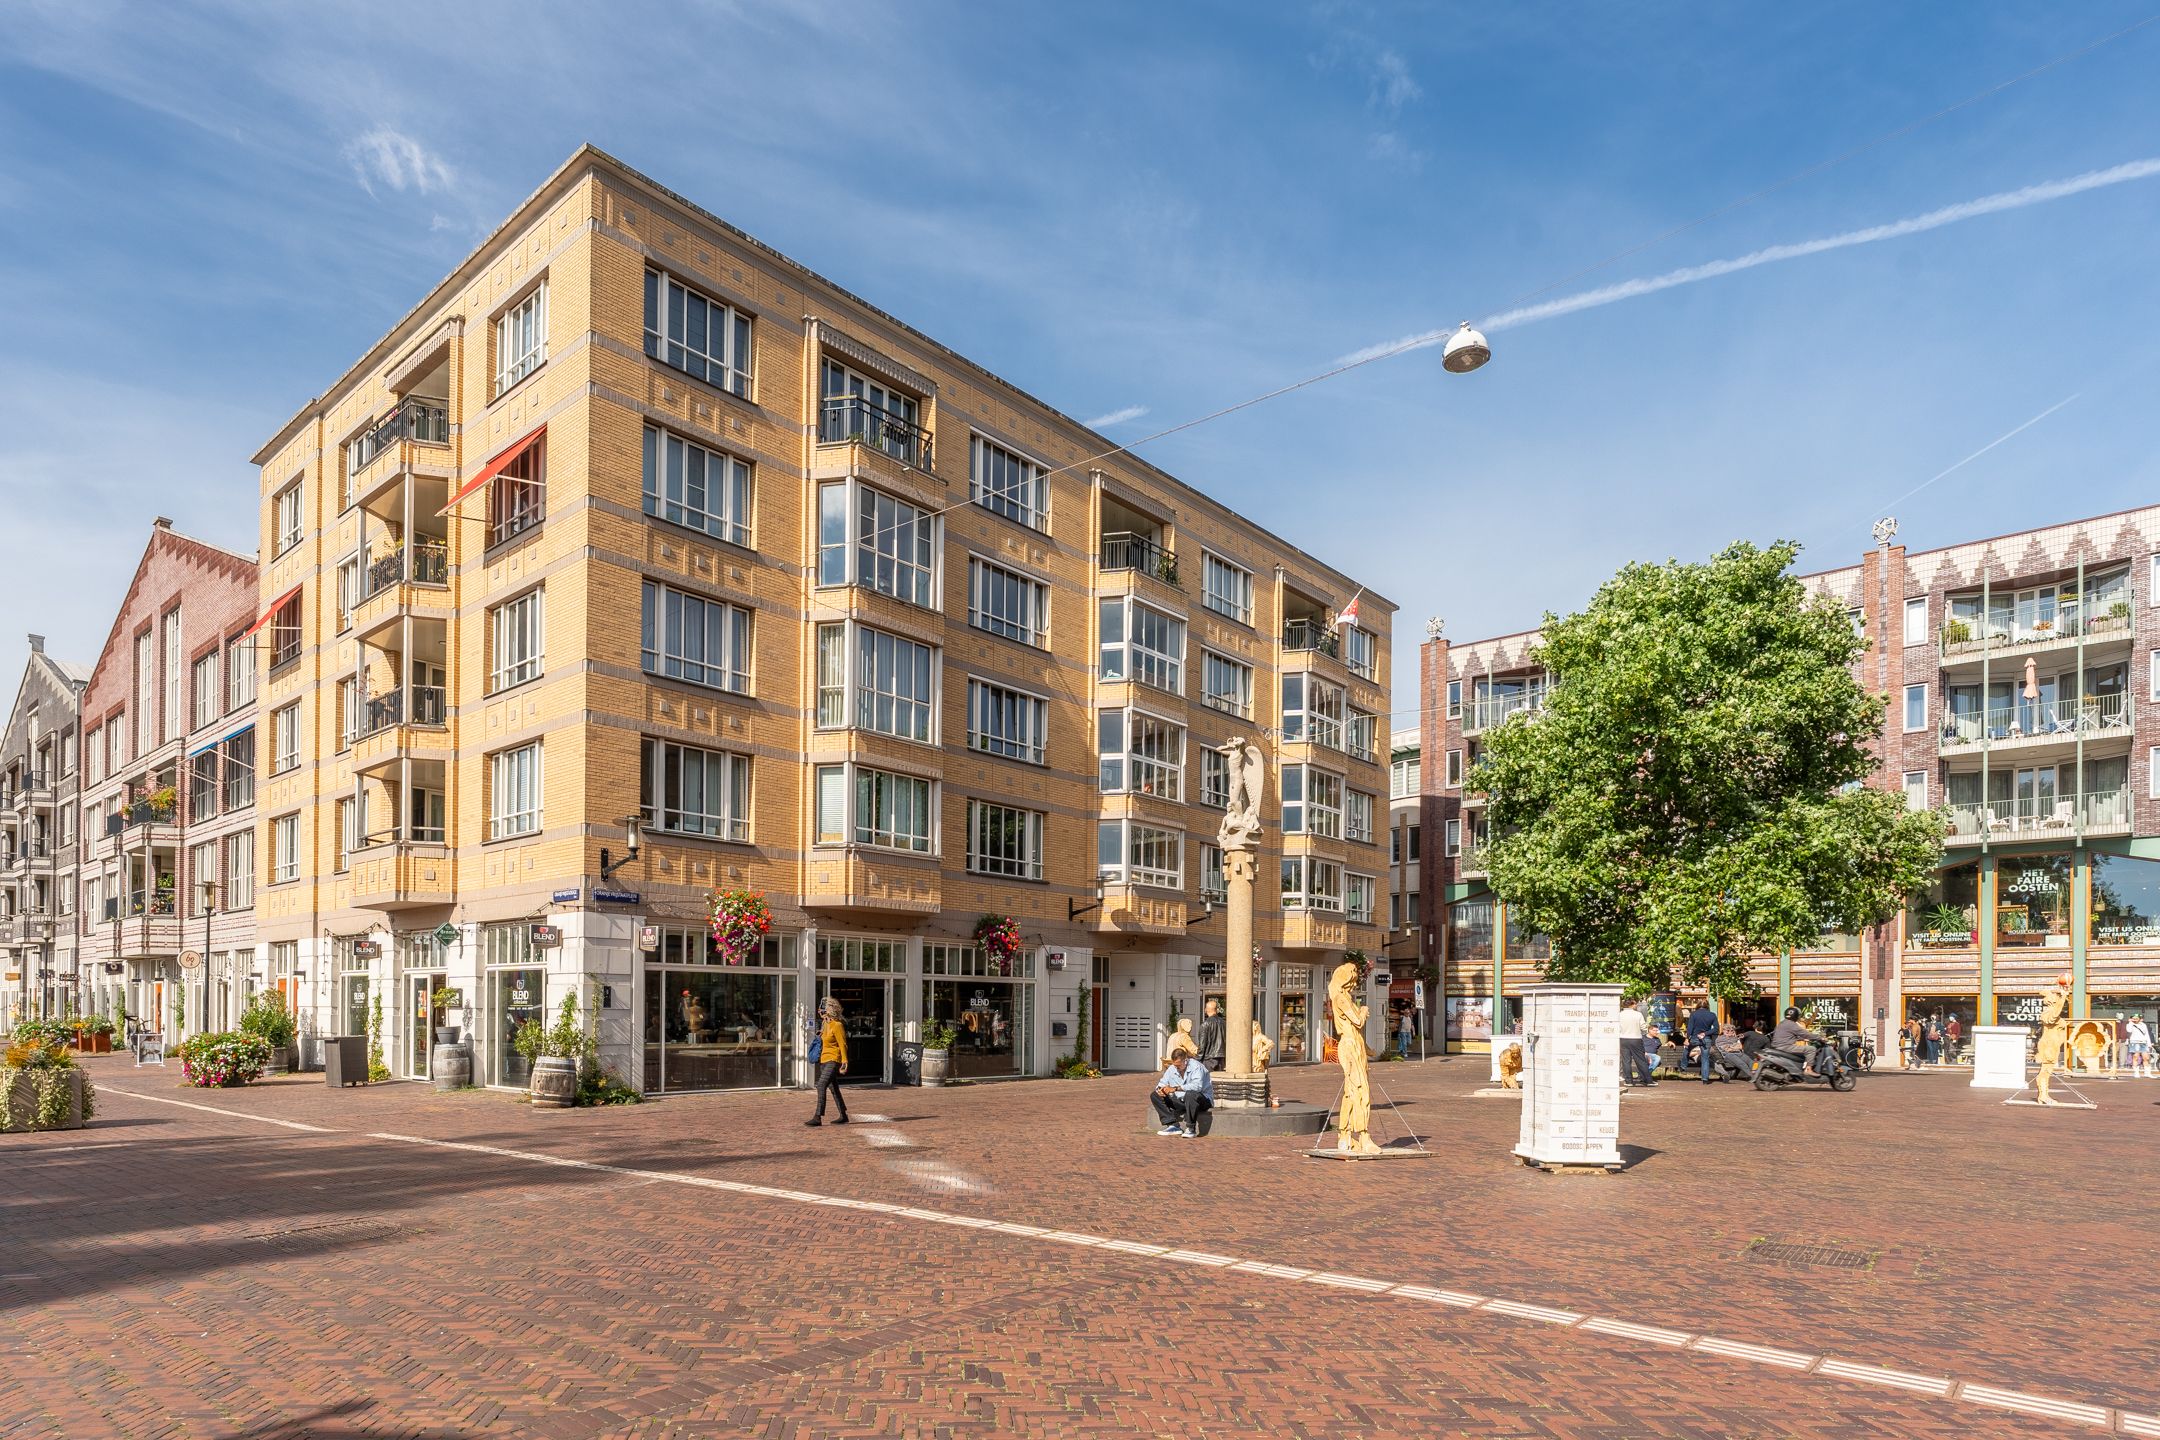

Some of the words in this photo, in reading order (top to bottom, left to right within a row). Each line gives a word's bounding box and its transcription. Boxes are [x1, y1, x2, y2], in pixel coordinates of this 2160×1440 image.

[2022, 868, 2045, 877] HET
[2017, 876, 2050, 885] FAIRE
[2008, 883, 2059, 892] OOSTEN
[533, 933, 555, 941] BLEND
[970, 998, 990, 1006] BLEND
[2021, 998, 2043, 1006] HET
